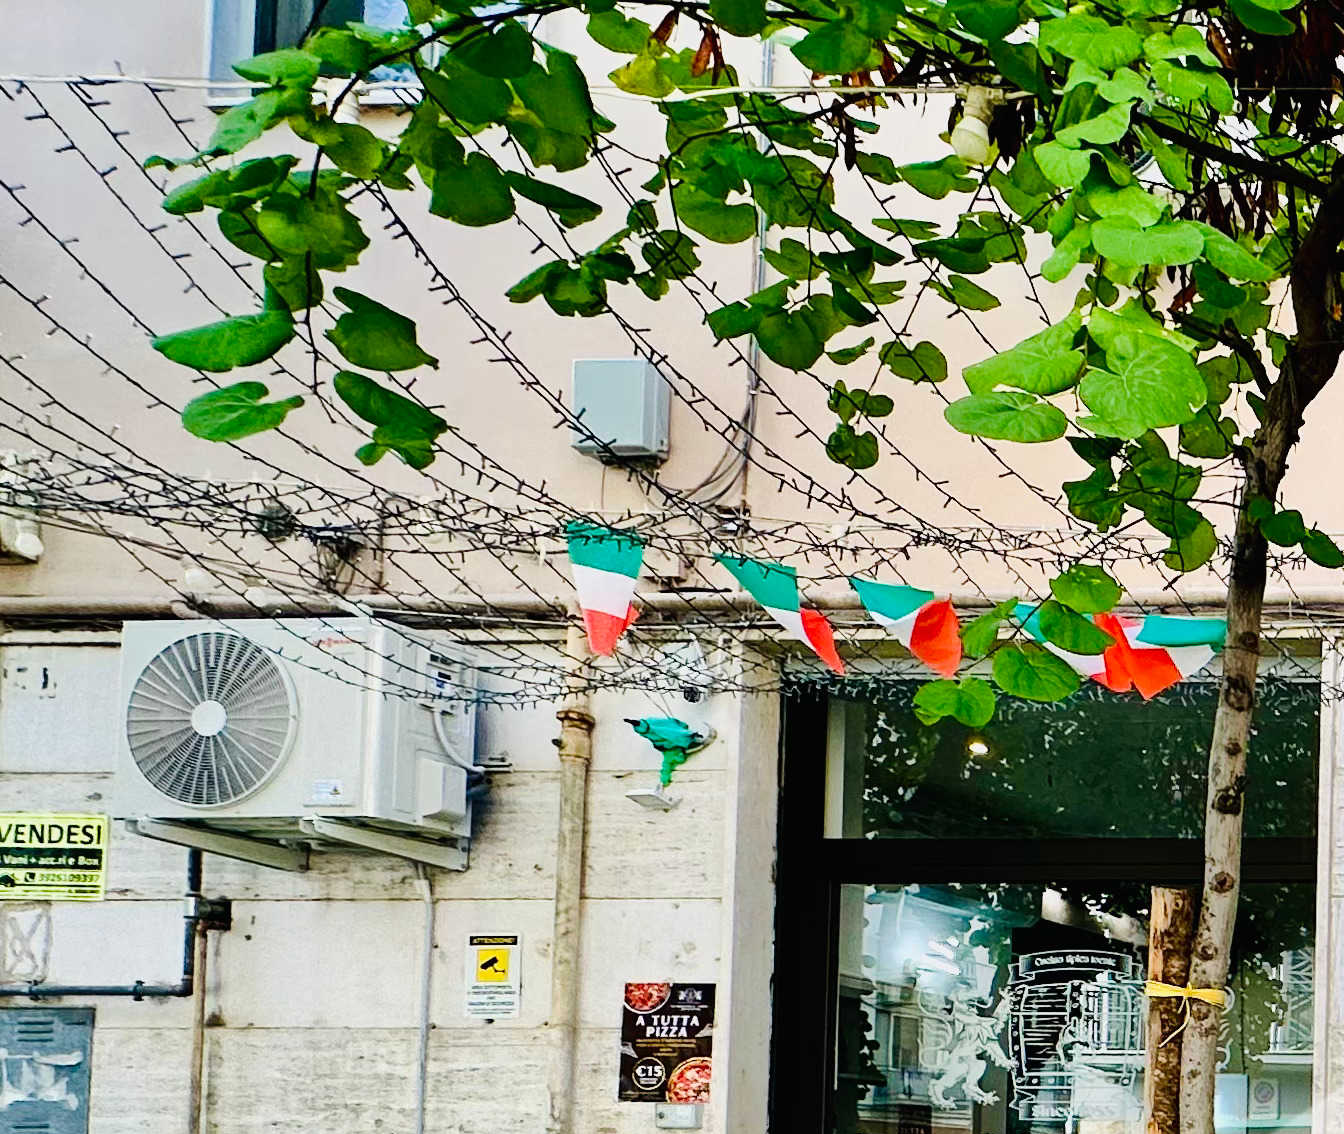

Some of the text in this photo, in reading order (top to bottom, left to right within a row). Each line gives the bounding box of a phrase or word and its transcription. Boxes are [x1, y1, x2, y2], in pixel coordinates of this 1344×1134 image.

[0, 823, 102, 844] VENDESI
[635, 1015, 700, 1027] A TUTTA
[645, 1027, 688, 1037] PIZZA
[636, 1065, 663, 1077] €15
